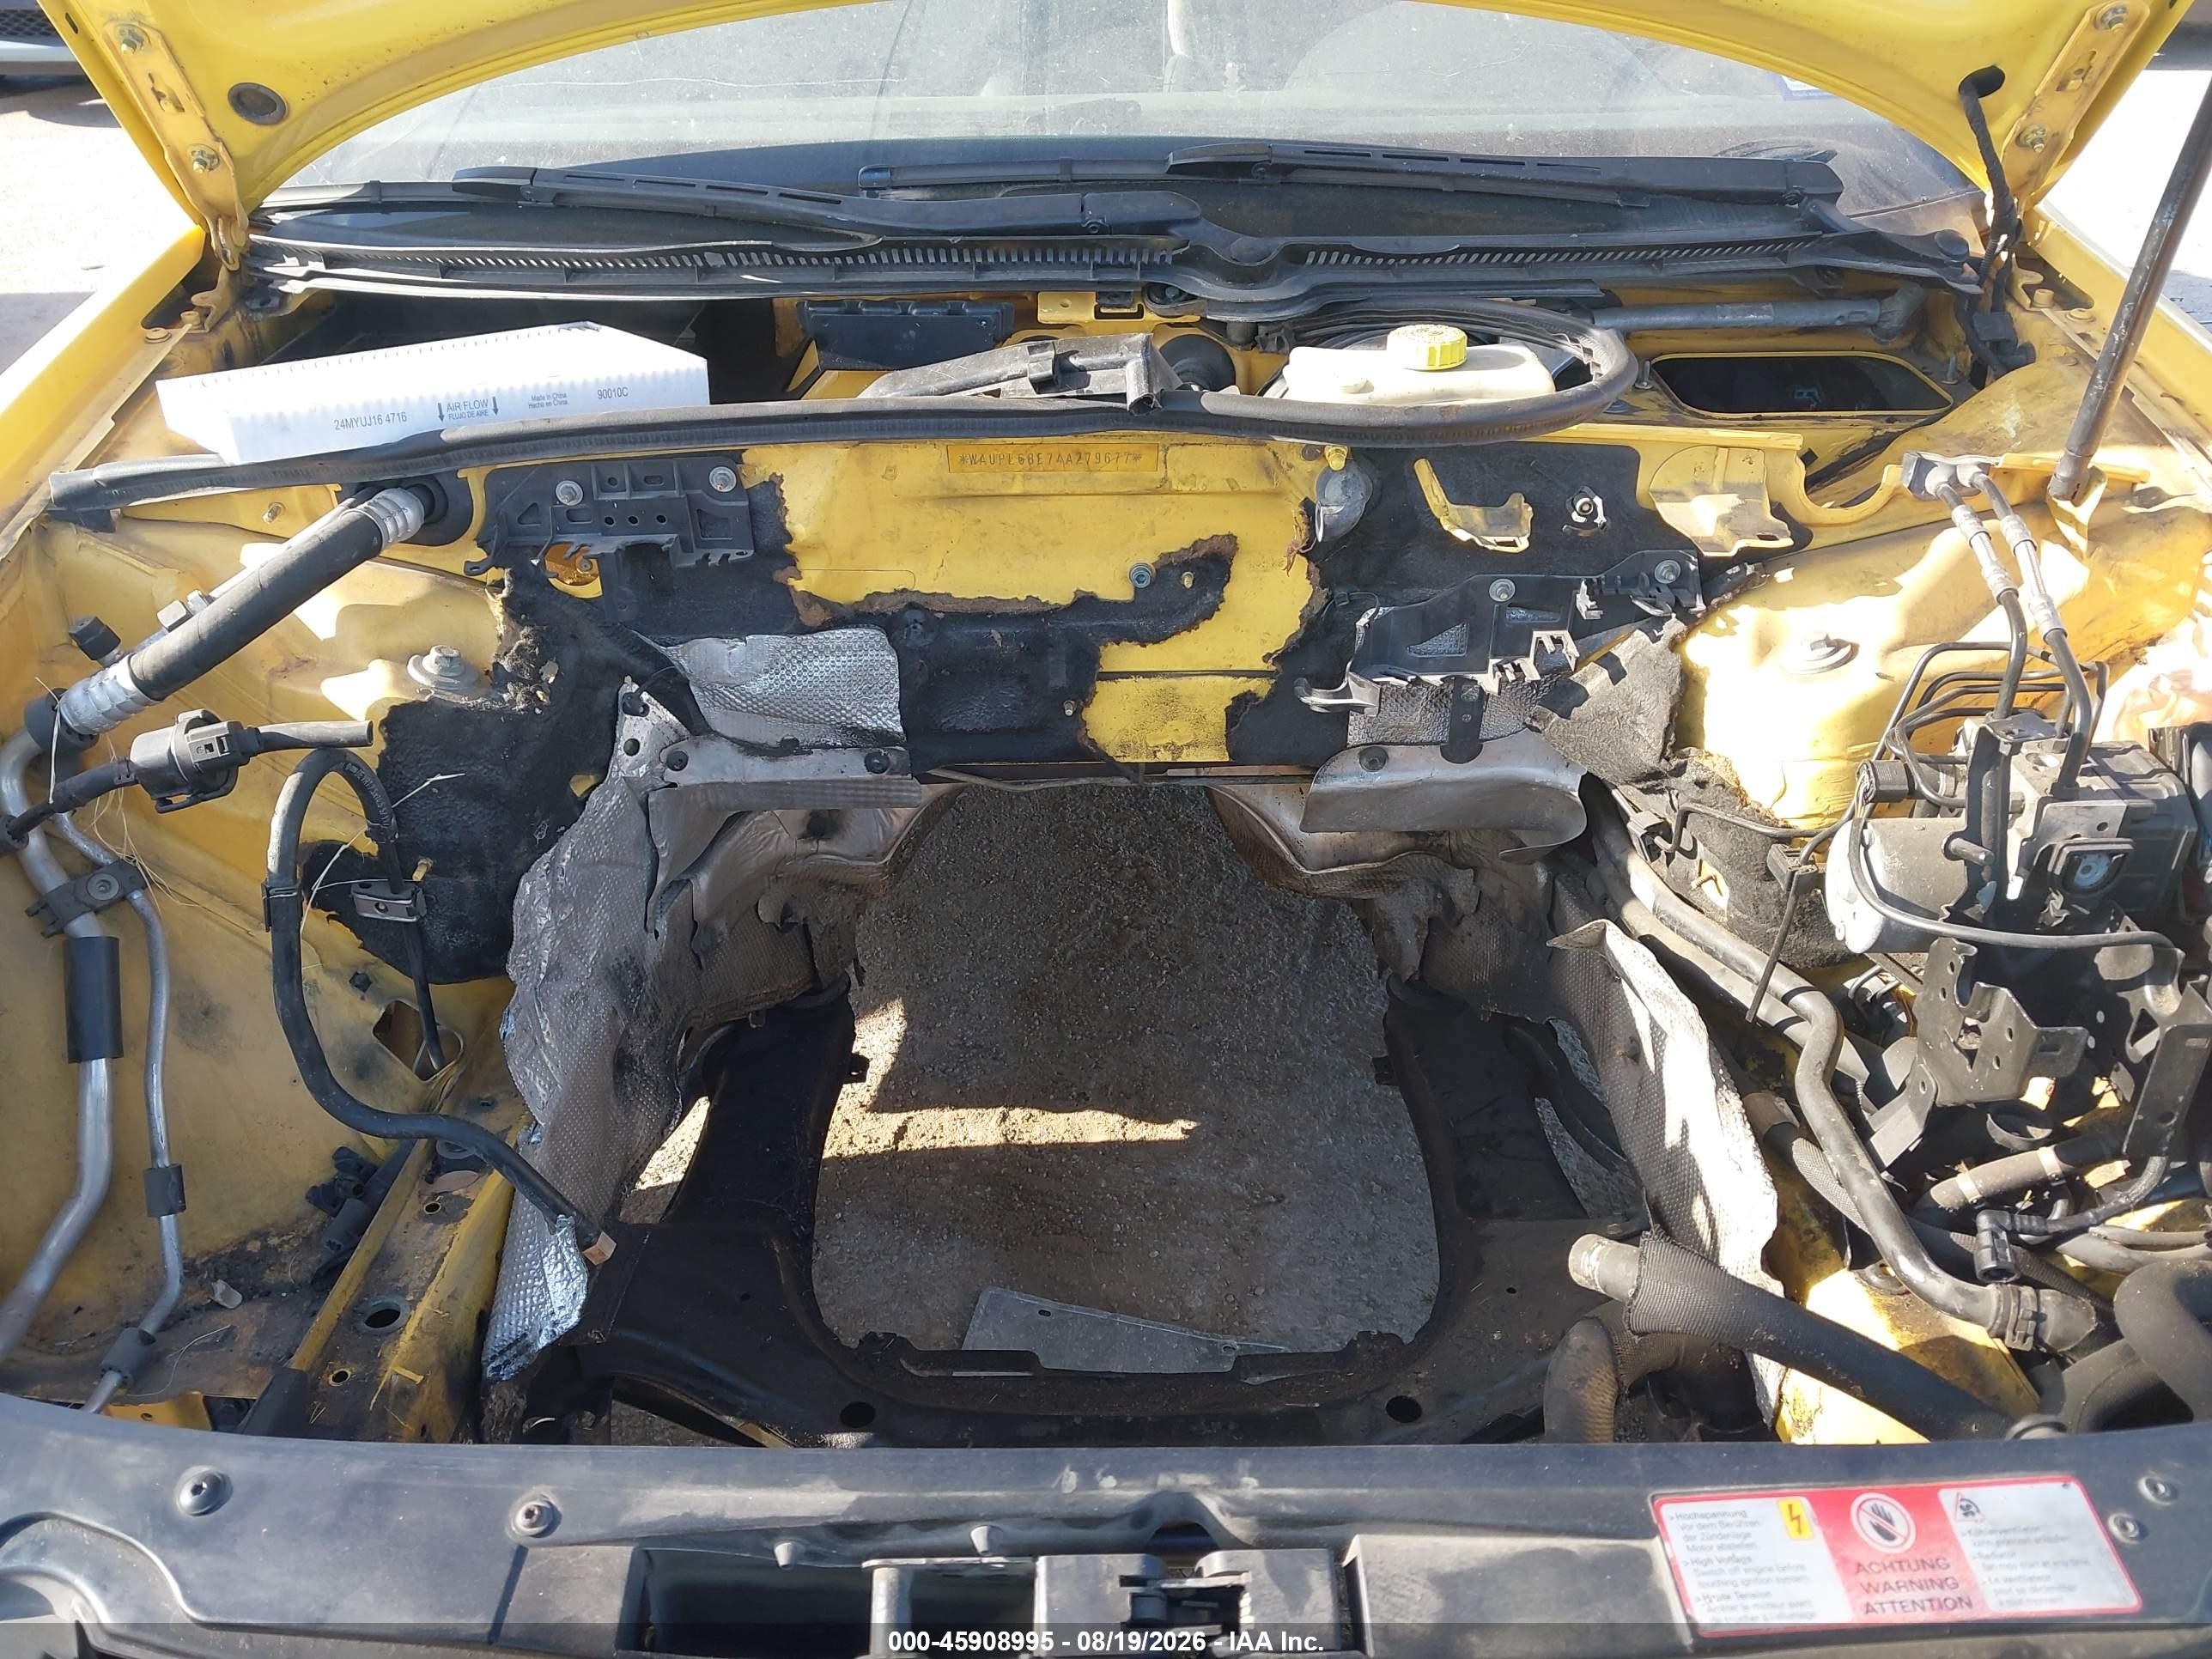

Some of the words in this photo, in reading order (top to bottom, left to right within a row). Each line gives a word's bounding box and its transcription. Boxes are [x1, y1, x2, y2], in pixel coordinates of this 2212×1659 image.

[531, 393, 545, 402] Made
[597, 386, 629, 399] 90010C
[447, 401, 461, 412] AIR
[463, 398, 488, 410] FLOW
[334, 414, 383, 430] 24MYUJ16
[386, 411, 407, 424] 4716
[448, 411, 467, 420] FLUJO
[476, 409, 489, 417] AIRE
[1855, 1557, 1951, 1575] ACHTUNG
[1860, 1577, 1960, 1595] WARNING
[1863, 1595, 1973, 1615] ATTENTION
